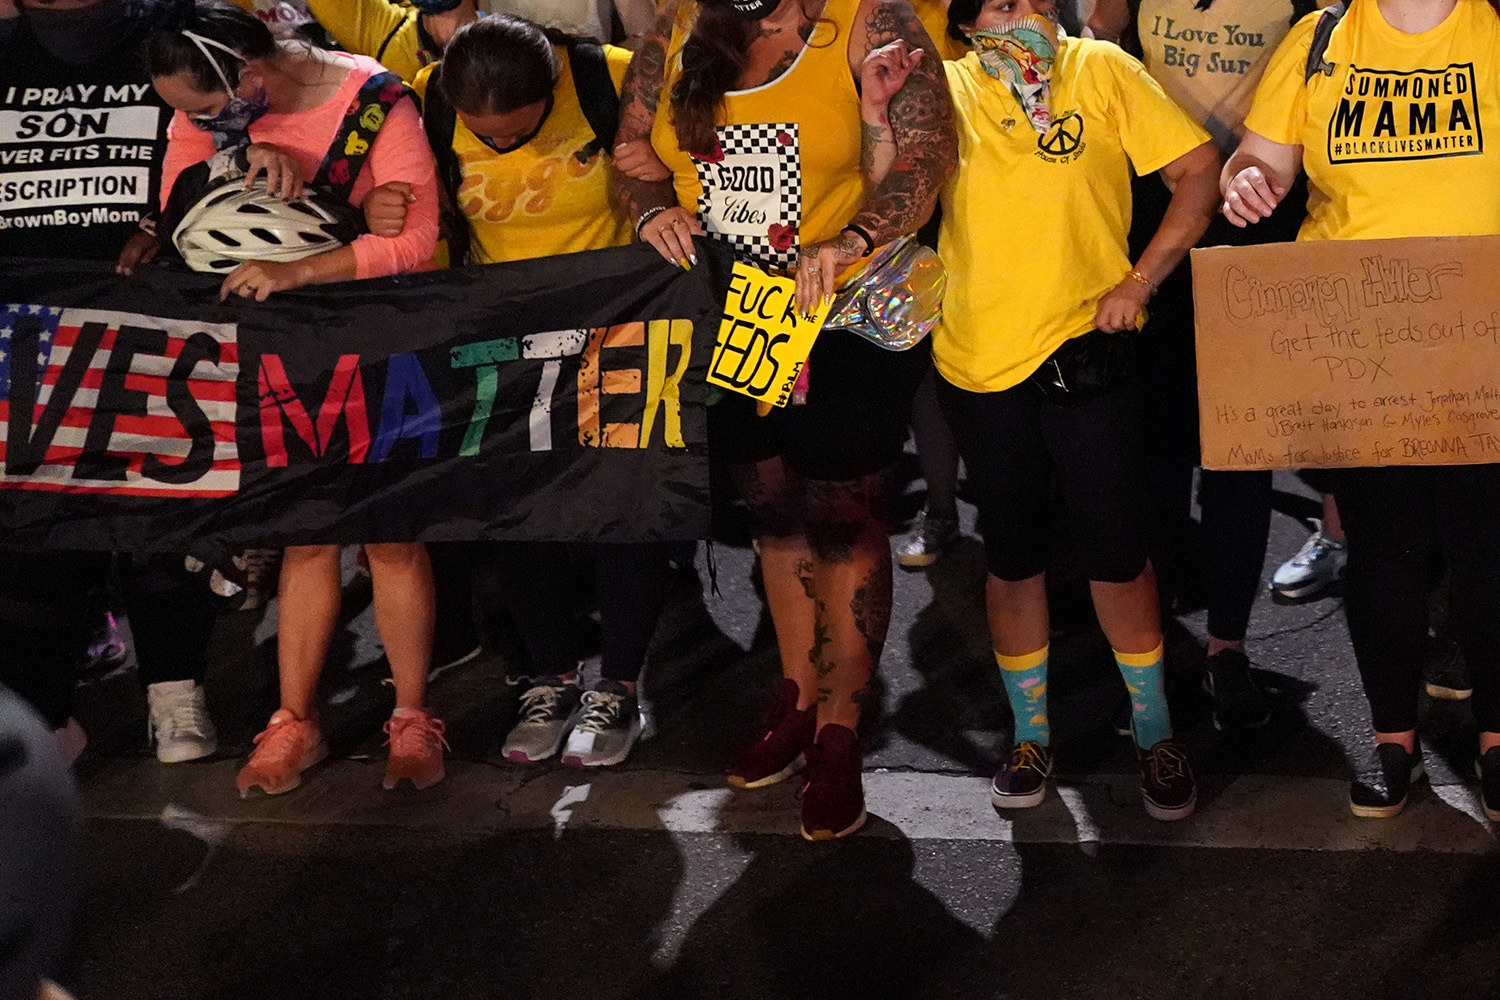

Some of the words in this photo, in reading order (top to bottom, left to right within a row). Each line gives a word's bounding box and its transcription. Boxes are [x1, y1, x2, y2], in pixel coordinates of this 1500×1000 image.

[1152, 16, 1162, 36] I
[1164, 18, 1218, 45] Love
[1223, 25, 1267, 47] You
[1164, 44, 1202, 78] Big
[1206, 52, 1251, 75] Sur
[5, 86, 17, 104] I
[22, 83, 98, 106] PRAY
[103, 83, 150, 103] MY
[1345, 72, 1468, 99] SUMMONED
[16, 111, 110, 139] SON
[1334, 97, 1472, 138] MAMA
[0, 148, 44, 165] VER
[50, 144, 100, 162] FITS
[107, 144, 153, 161] THE
[1334, 134, 1474, 156] #BLACKLIVESMATTER
[0, 175, 137, 201] SCRIPTION
[717, 165, 775, 193] GOOD
[721, 196, 767, 225] Vibes
[1270, 323, 1318, 360] Get
[1326, 323, 1369, 351] the
[1375, 316, 1423, 350] feds
[1427, 311, 1466, 343] out
[1473, 311, 1500, 344] of
[776, 360, 805, 407] #BLM
[1312, 354, 1394, 384] PDX
[258, 318, 695, 468] MATTER
[1245, 407, 1256, 423] a
[1265, 400, 1303, 437] great
[1312, 400, 1342, 418] day
[1350, 398, 1367, 410] to
[1373, 393, 1418, 408] arrest
[1283, 443, 1309, 466] for
[1372, 441, 1394, 462] for
